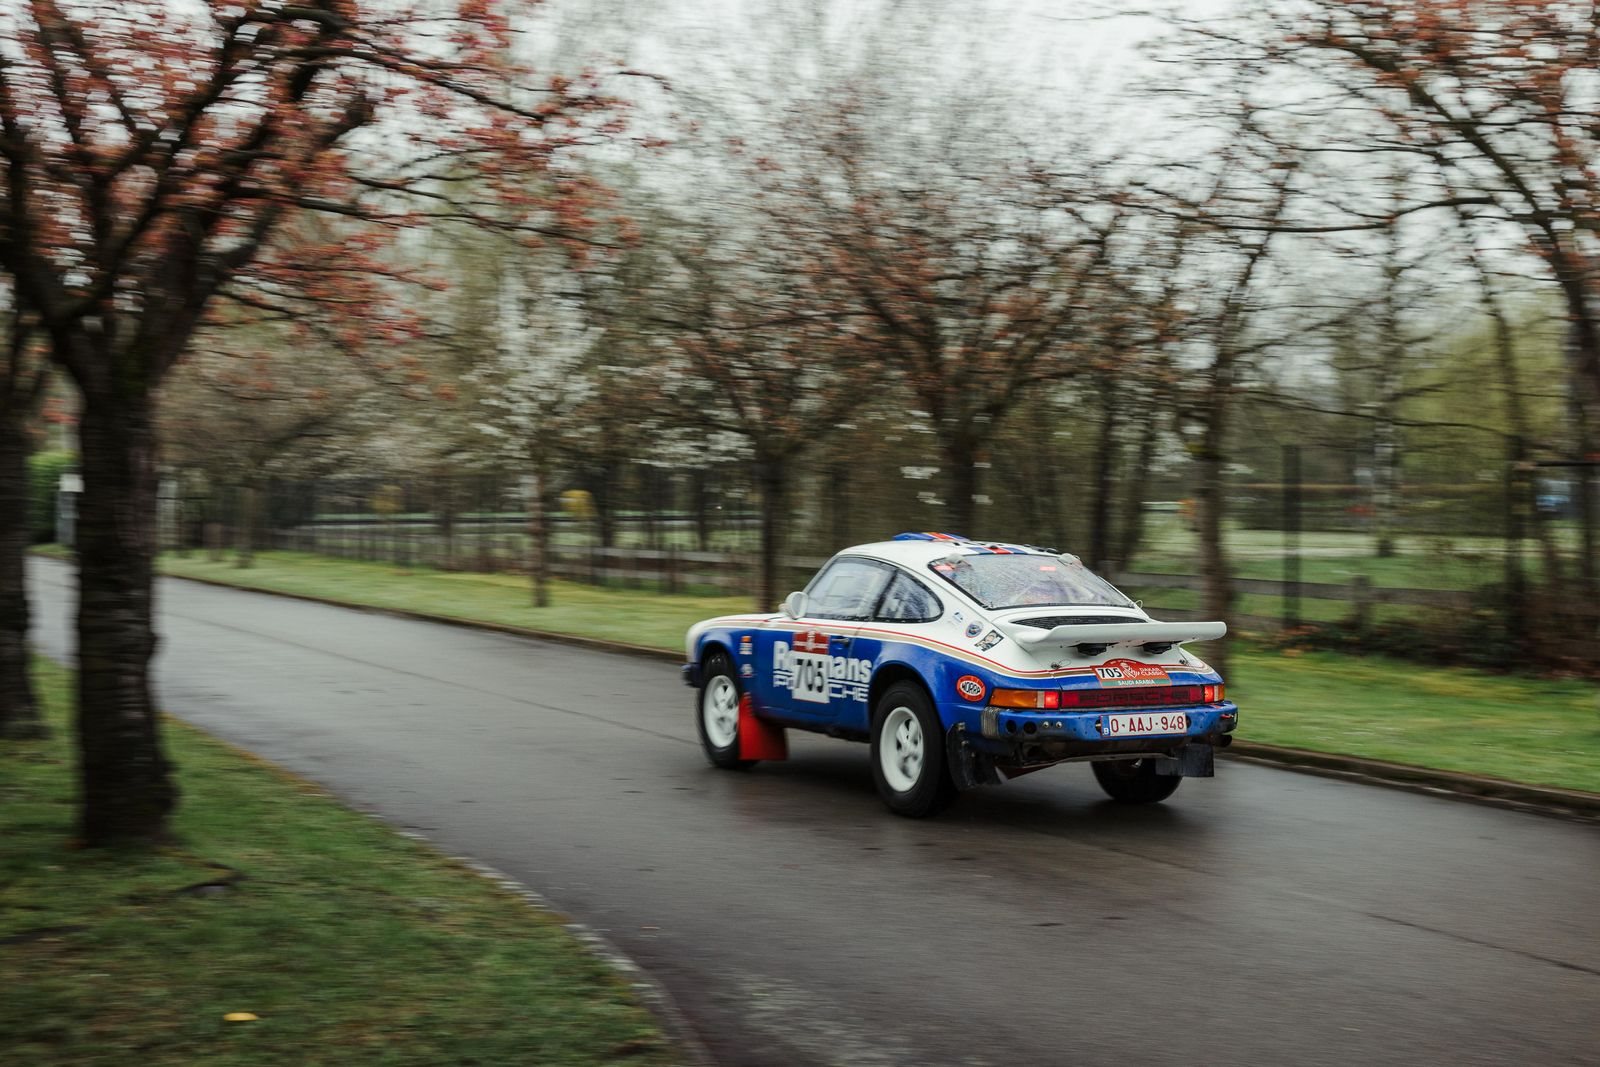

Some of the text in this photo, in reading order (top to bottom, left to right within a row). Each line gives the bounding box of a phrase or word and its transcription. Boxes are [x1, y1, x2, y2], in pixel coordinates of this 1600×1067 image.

[796, 658, 824, 693] 705
[1097, 667, 1122, 679] 705
[1079, 690, 1189, 705] PORSCHE
